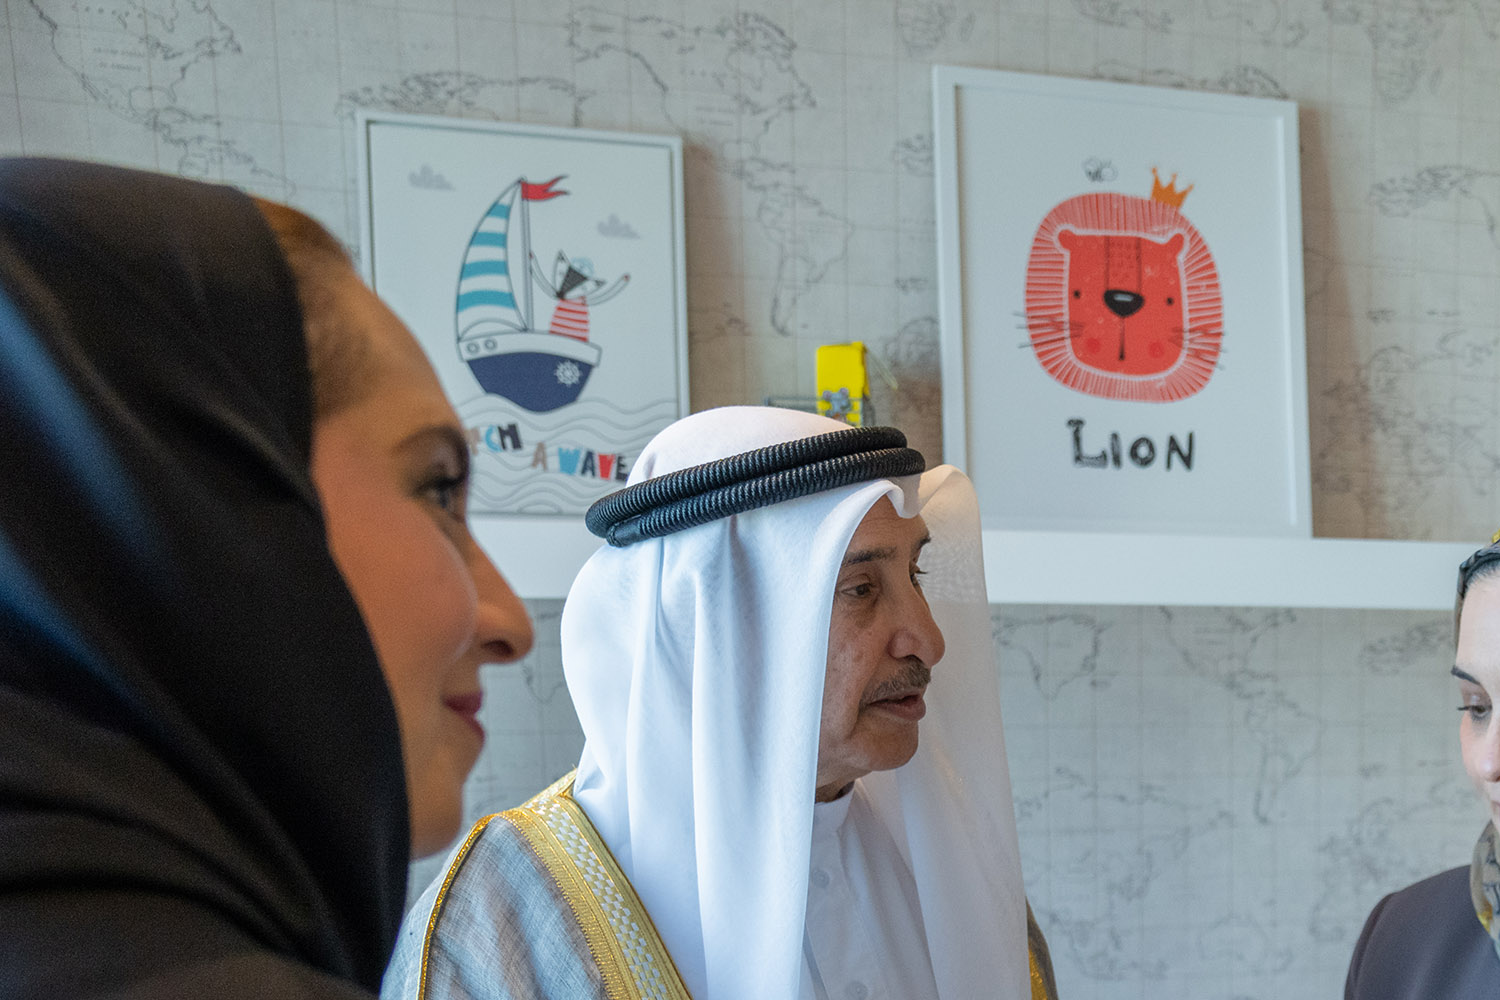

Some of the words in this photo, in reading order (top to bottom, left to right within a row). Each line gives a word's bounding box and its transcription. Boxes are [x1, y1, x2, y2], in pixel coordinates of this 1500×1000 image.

[531, 441, 548, 472] A
[558, 447, 629, 482] WAVE
[1066, 418, 1195, 472] LION
